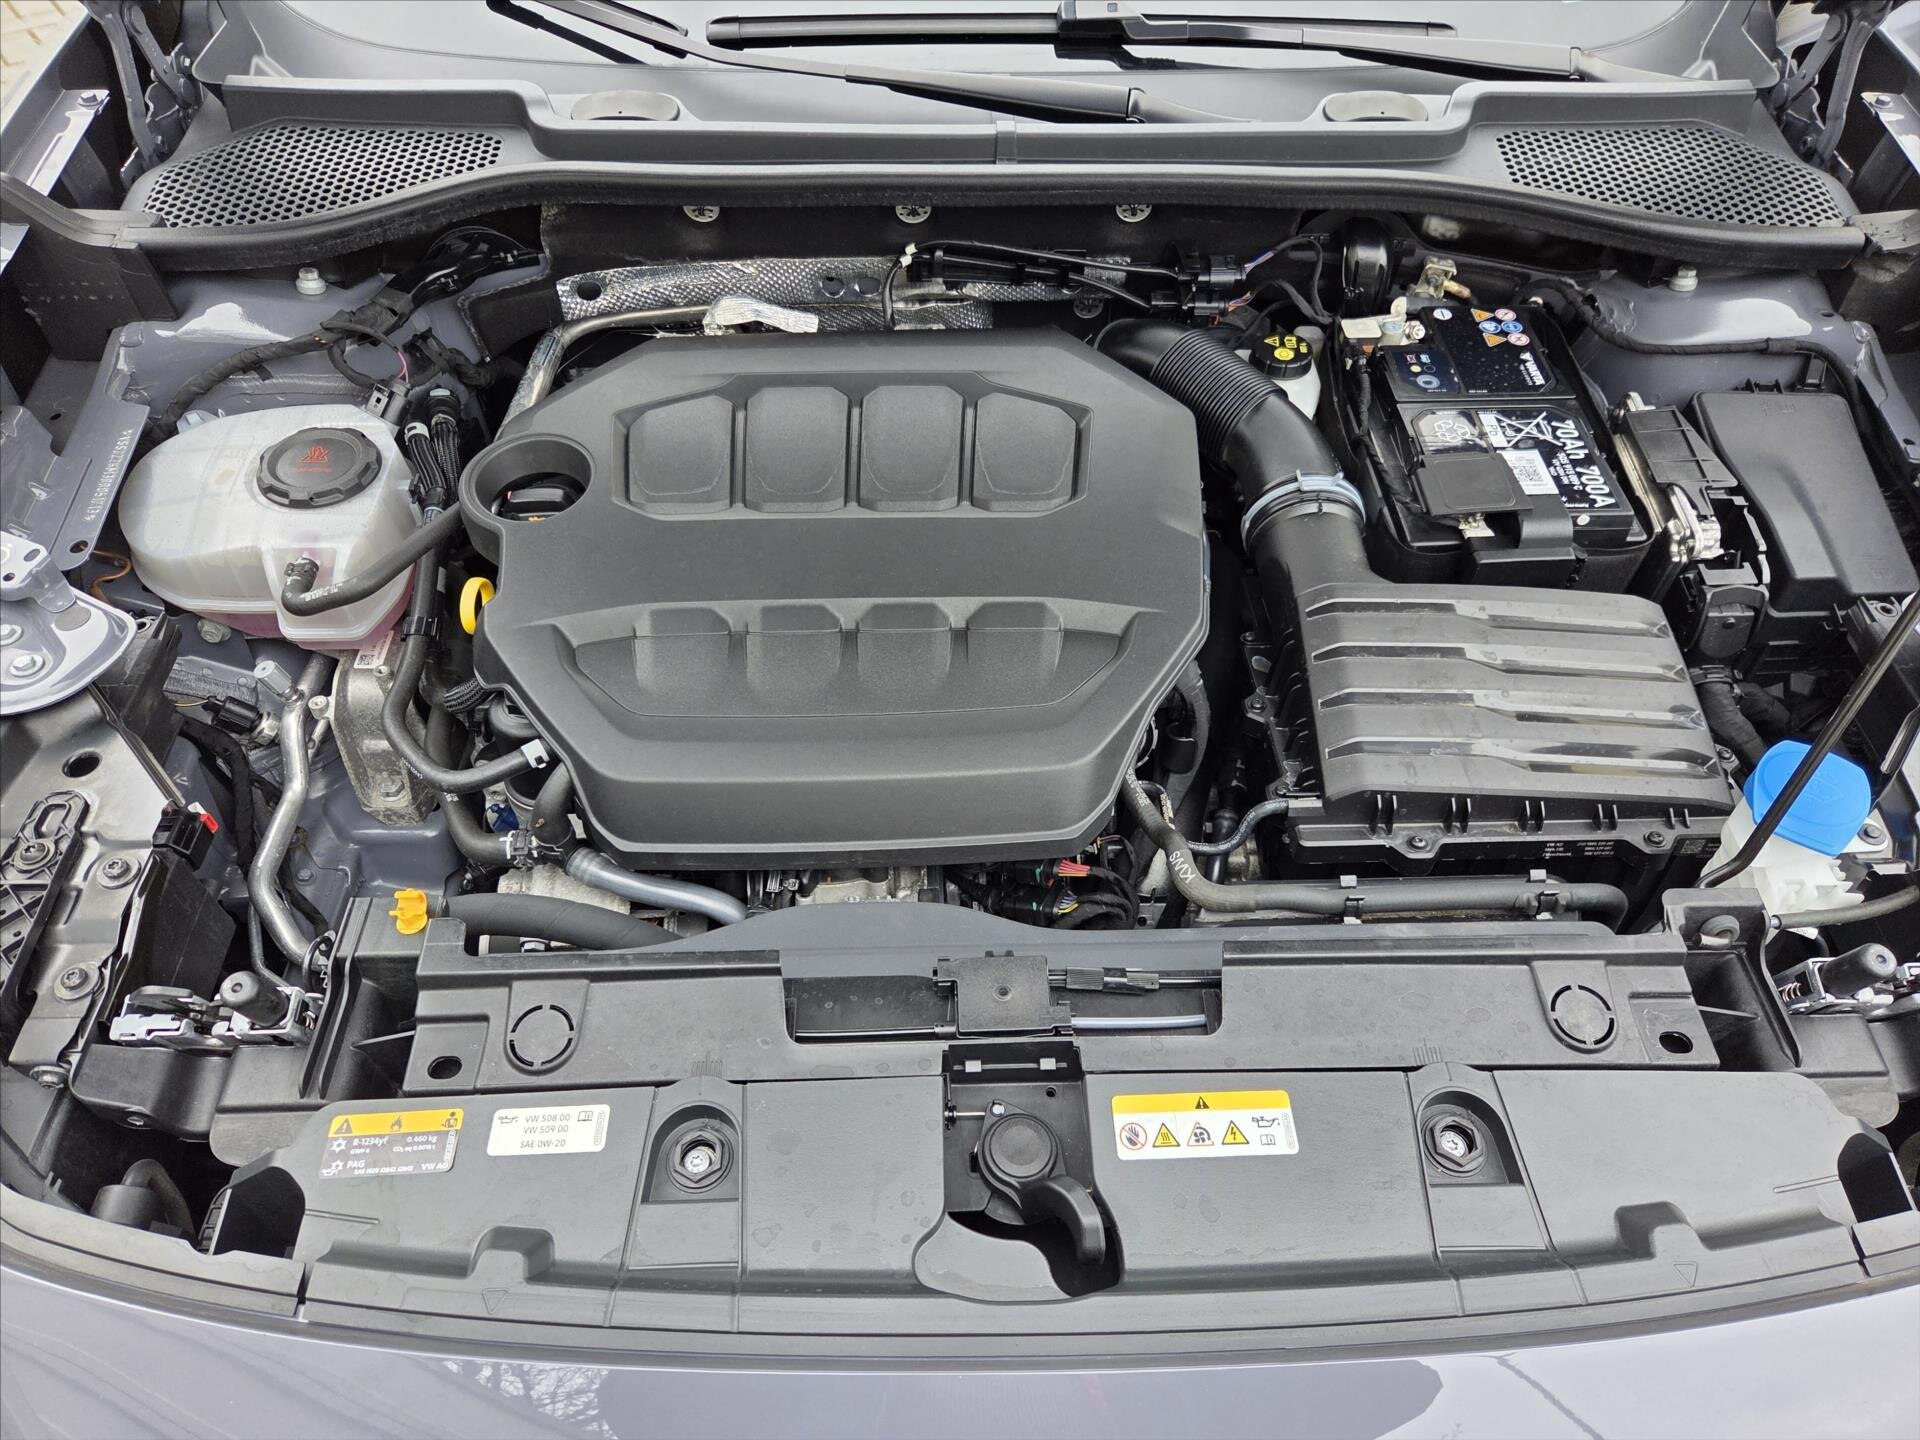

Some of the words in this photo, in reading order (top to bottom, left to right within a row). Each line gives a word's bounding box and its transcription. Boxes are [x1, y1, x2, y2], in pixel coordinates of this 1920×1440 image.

[1551, 419, 1589, 460] 70Ah
[1576, 465, 1616, 508] 700A
[1169, 850, 1197, 884] KWS
[525, 1114, 540, 1123] VW
[541, 1114, 558, 1123] 508
[560, 1113, 571, 1122] 00
[523, 1126, 538, 1135] VW
[539, 1125, 556, 1134] 509
[557, 1124, 569, 1133] 00
[352, 1135, 389, 1147] R-1234yf
[520, 1140, 535, 1149] SAE
[537, 1138, 566, 1148] 0W-20
[347, 1160, 365, 1169] PAG
